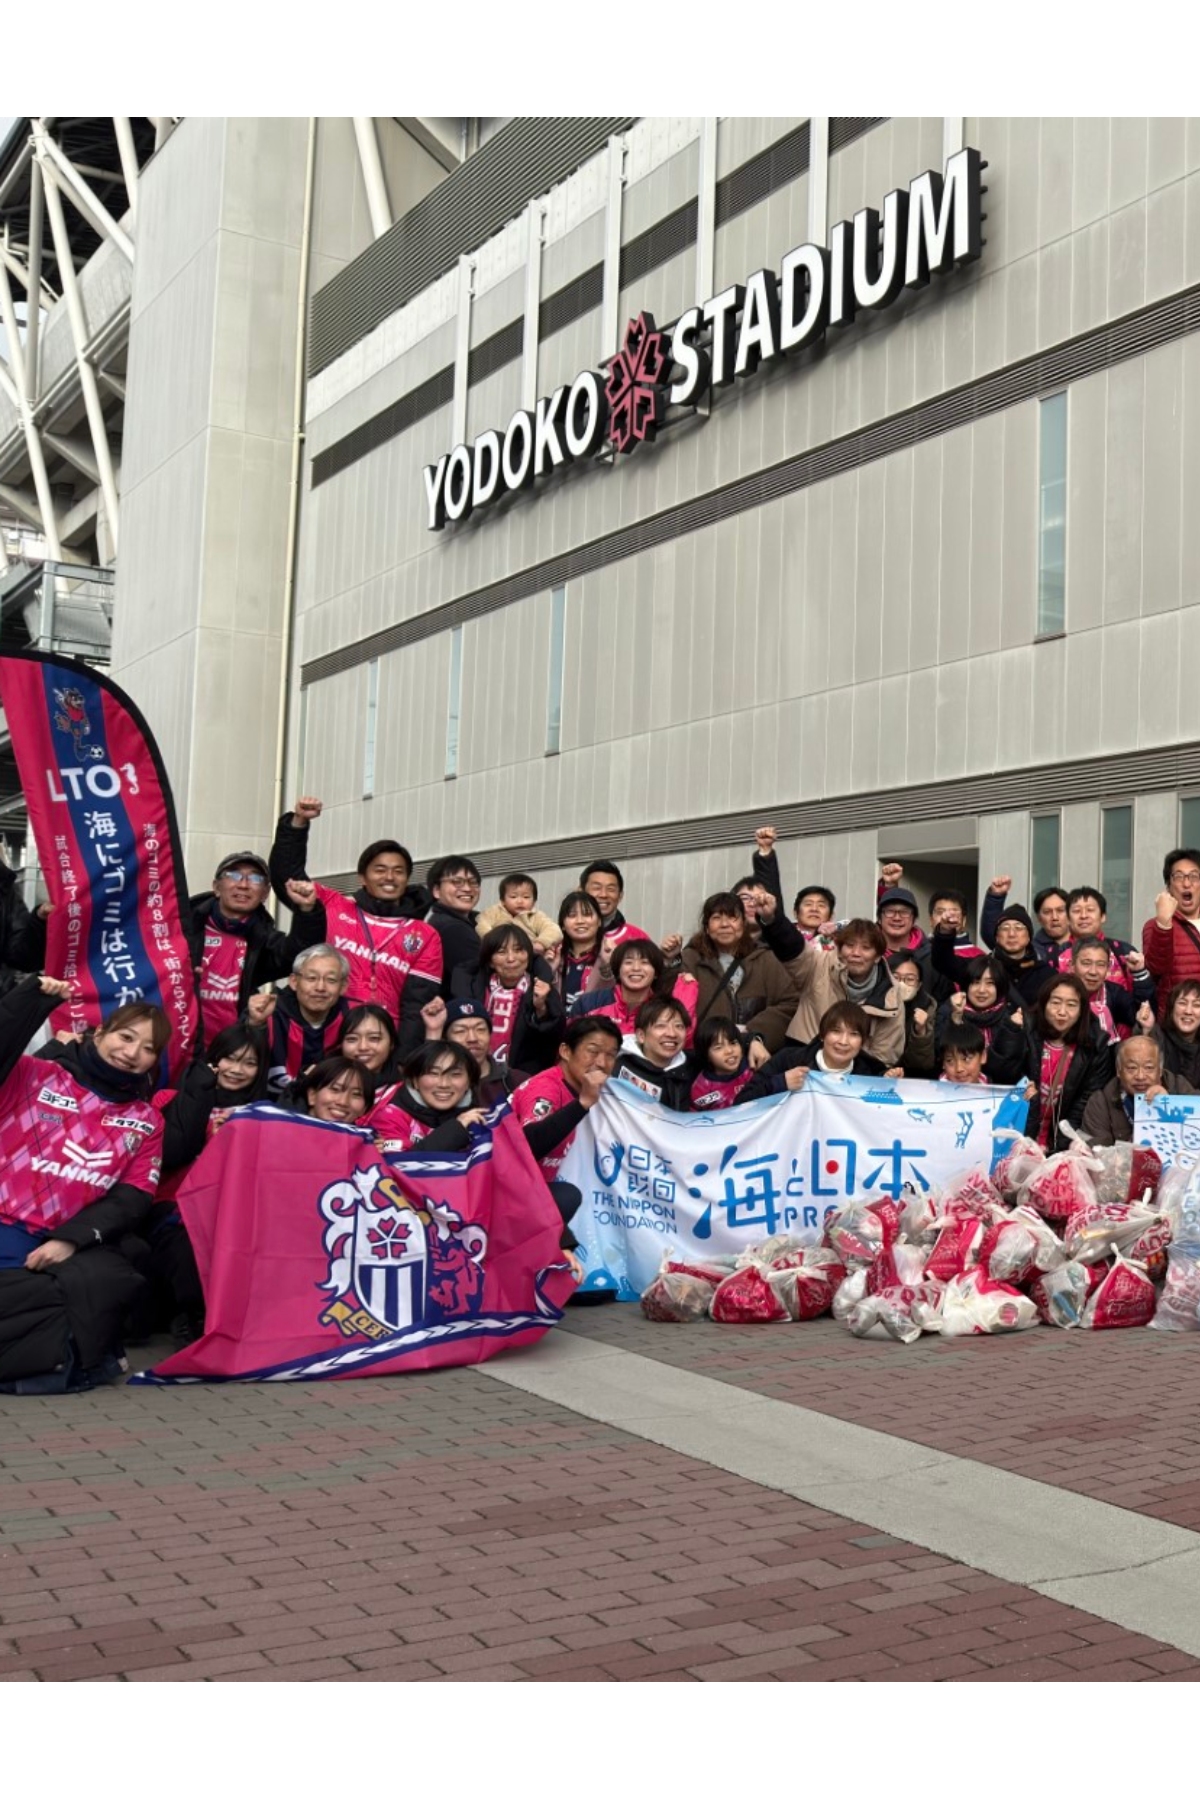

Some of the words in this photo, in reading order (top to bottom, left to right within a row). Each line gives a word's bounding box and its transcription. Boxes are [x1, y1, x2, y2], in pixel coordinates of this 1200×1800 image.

[423, 370, 600, 530] YODOKO
[669, 147, 982, 405] STADIUM
[46, 766, 122, 802] LTO
[84, 810, 145, 1007] 海にゴミは行か
[334, 935, 411, 974] YANMAR
[628, 1144, 673, 1175] 日本
[592, 1190, 615, 1207] THE
[618, 1195, 676, 1220] NIPPON
[688, 1139, 930, 1239] 海と日本
